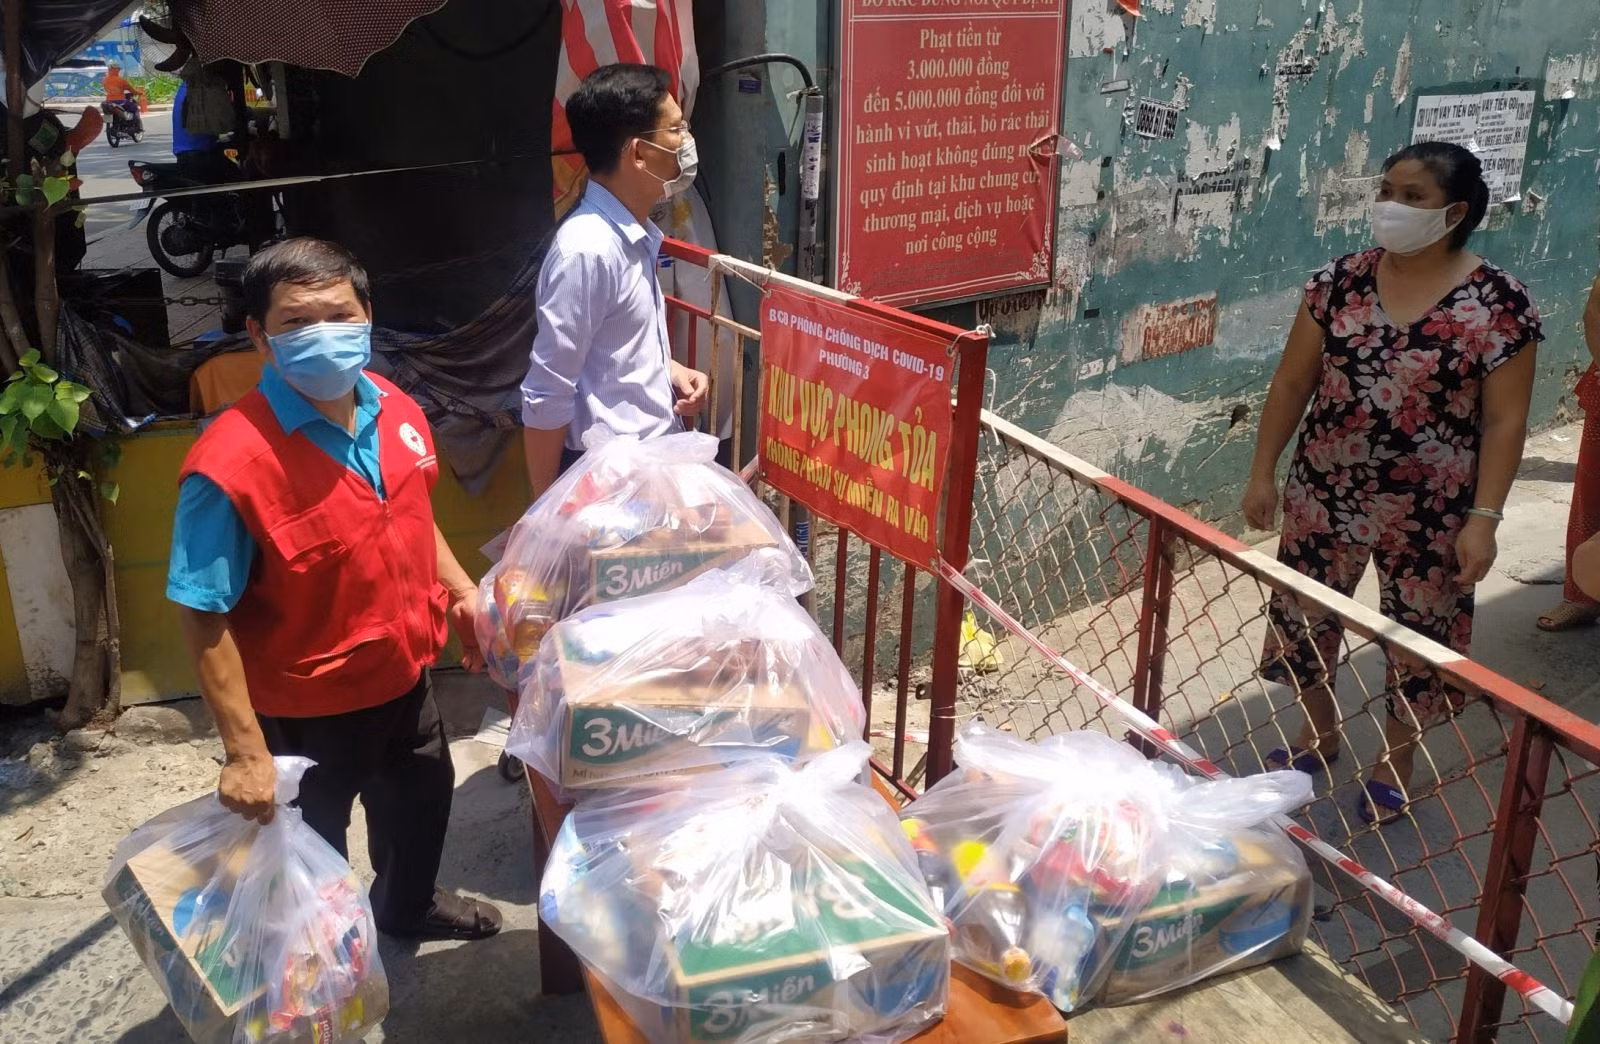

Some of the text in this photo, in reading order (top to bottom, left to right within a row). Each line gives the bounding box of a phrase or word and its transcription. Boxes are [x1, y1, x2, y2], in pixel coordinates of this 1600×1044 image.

[919, 21, 1002, 53] Phạt tiền từ
[906, 51, 1010, 80] 3.000.000 đồng
[863, 78, 1045, 113] đến 5.000.000 đồng đối với
[856, 110, 1049, 144] hành vi vứt, thải, bỏ rác thải
[866, 152, 896, 174] sinh
[901, 150, 931, 173] hoạt
[936, 144, 978, 167] không
[982, 141, 1015, 163] đúng
[860, 187, 887, 209] quy
[892, 178, 924, 204] định
[928, 175, 946, 200] tại
[950, 173, 976, 192] khu
[979, 170, 1019, 190] chung
[863, 194, 1035, 232] thương mại, dịch vụ hoặc
[905, 226, 997, 255] nơi công cộng
[790, 315, 823, 338] PHÒNG
[825, 327, 861, 351] CHỐNG
[863, 338, 889, 361] DỊCH
[892, 349, 945, 382] COVID-19
[819, 348, 870, 380] PHƯỜNG 3
[768, 364, 937, 493] KHU VỰC PHONG TỎA
[766, 436, 929, 543] KHÔNG PHẬN SỰ MIỄN RA VÀO
